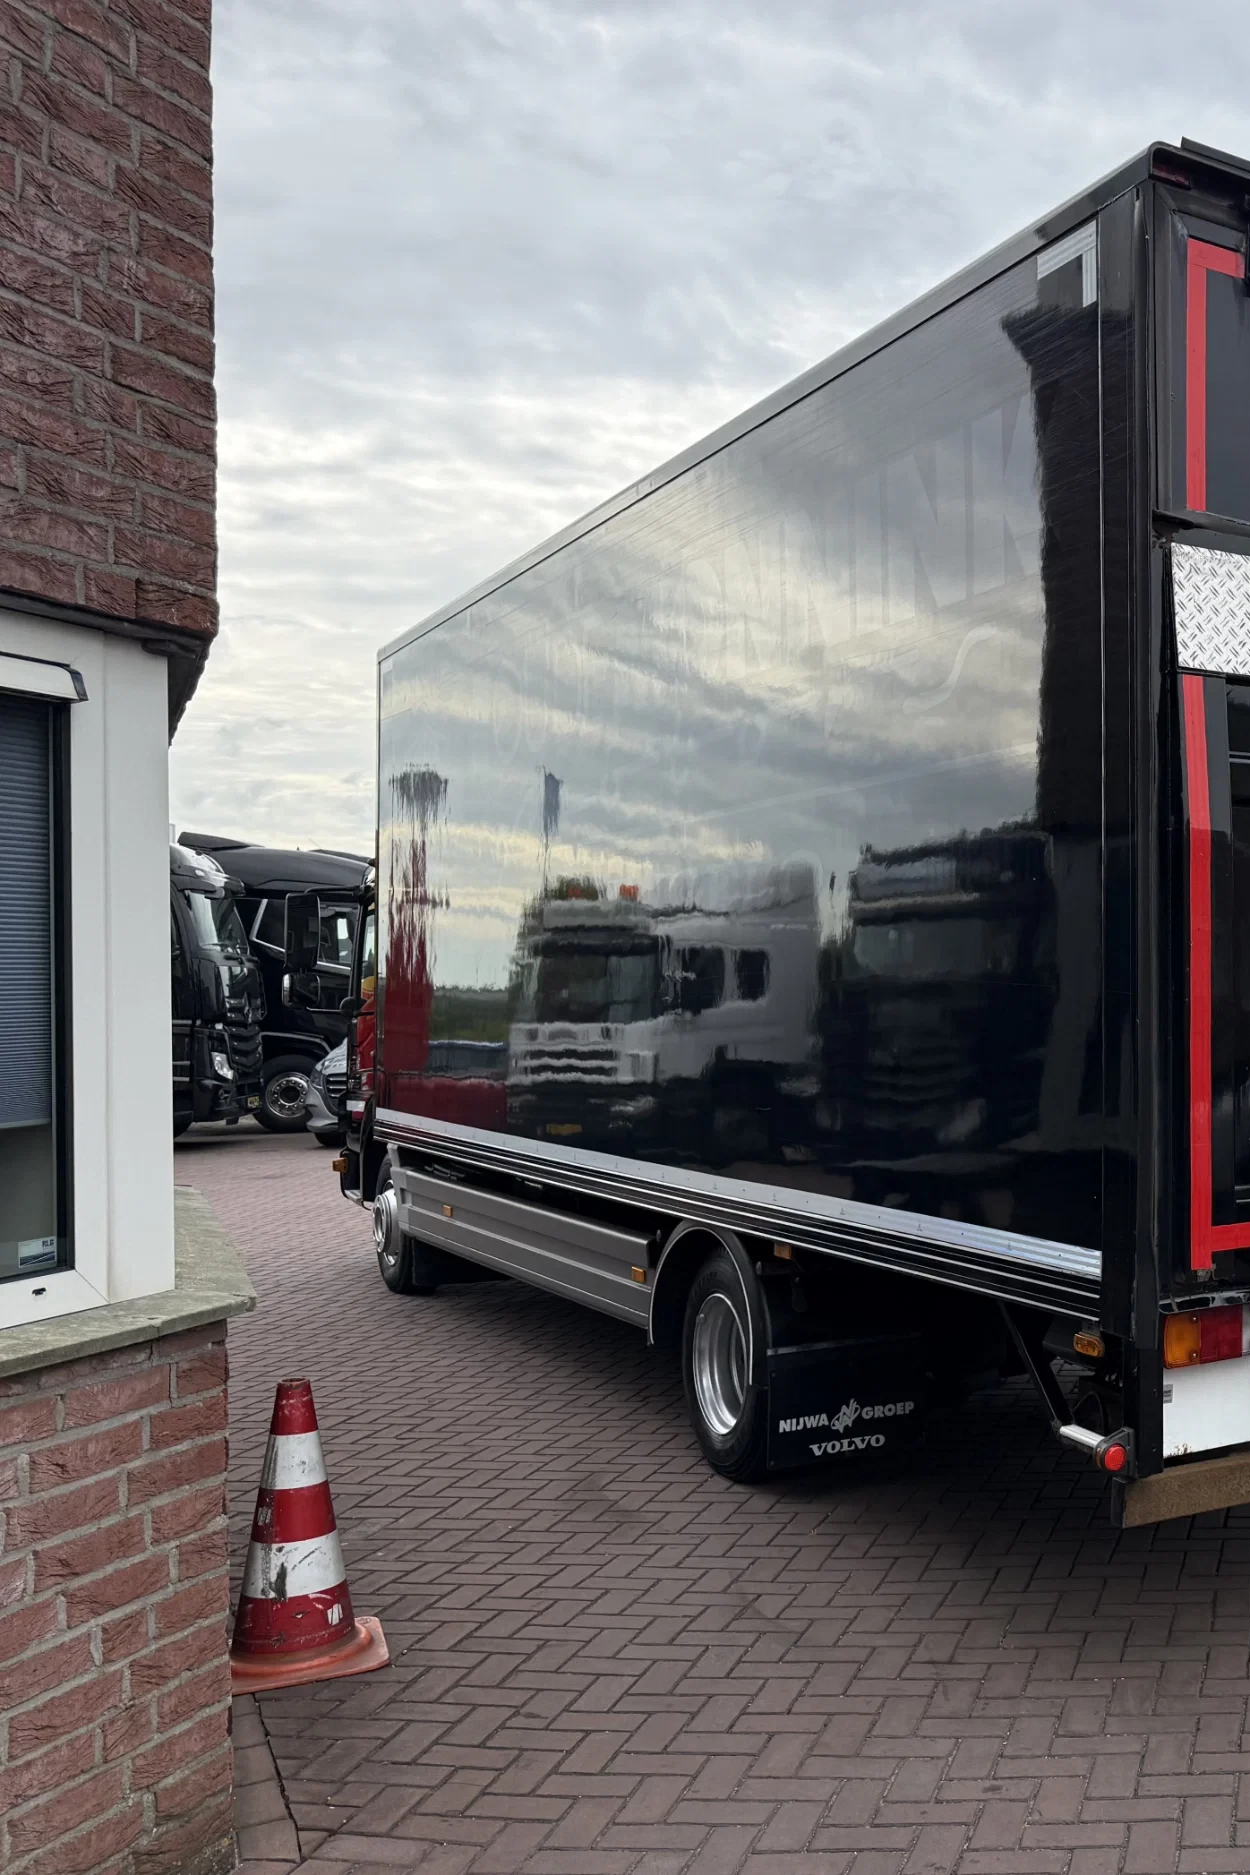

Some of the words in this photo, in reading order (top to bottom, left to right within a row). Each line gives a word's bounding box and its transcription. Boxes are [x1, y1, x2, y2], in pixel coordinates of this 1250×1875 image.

[778, 1413, 829, 1434] NIJWA
[861, 1401, 915, 1420] GROEP
[808, 1434, 886, 1457] VOLVO
